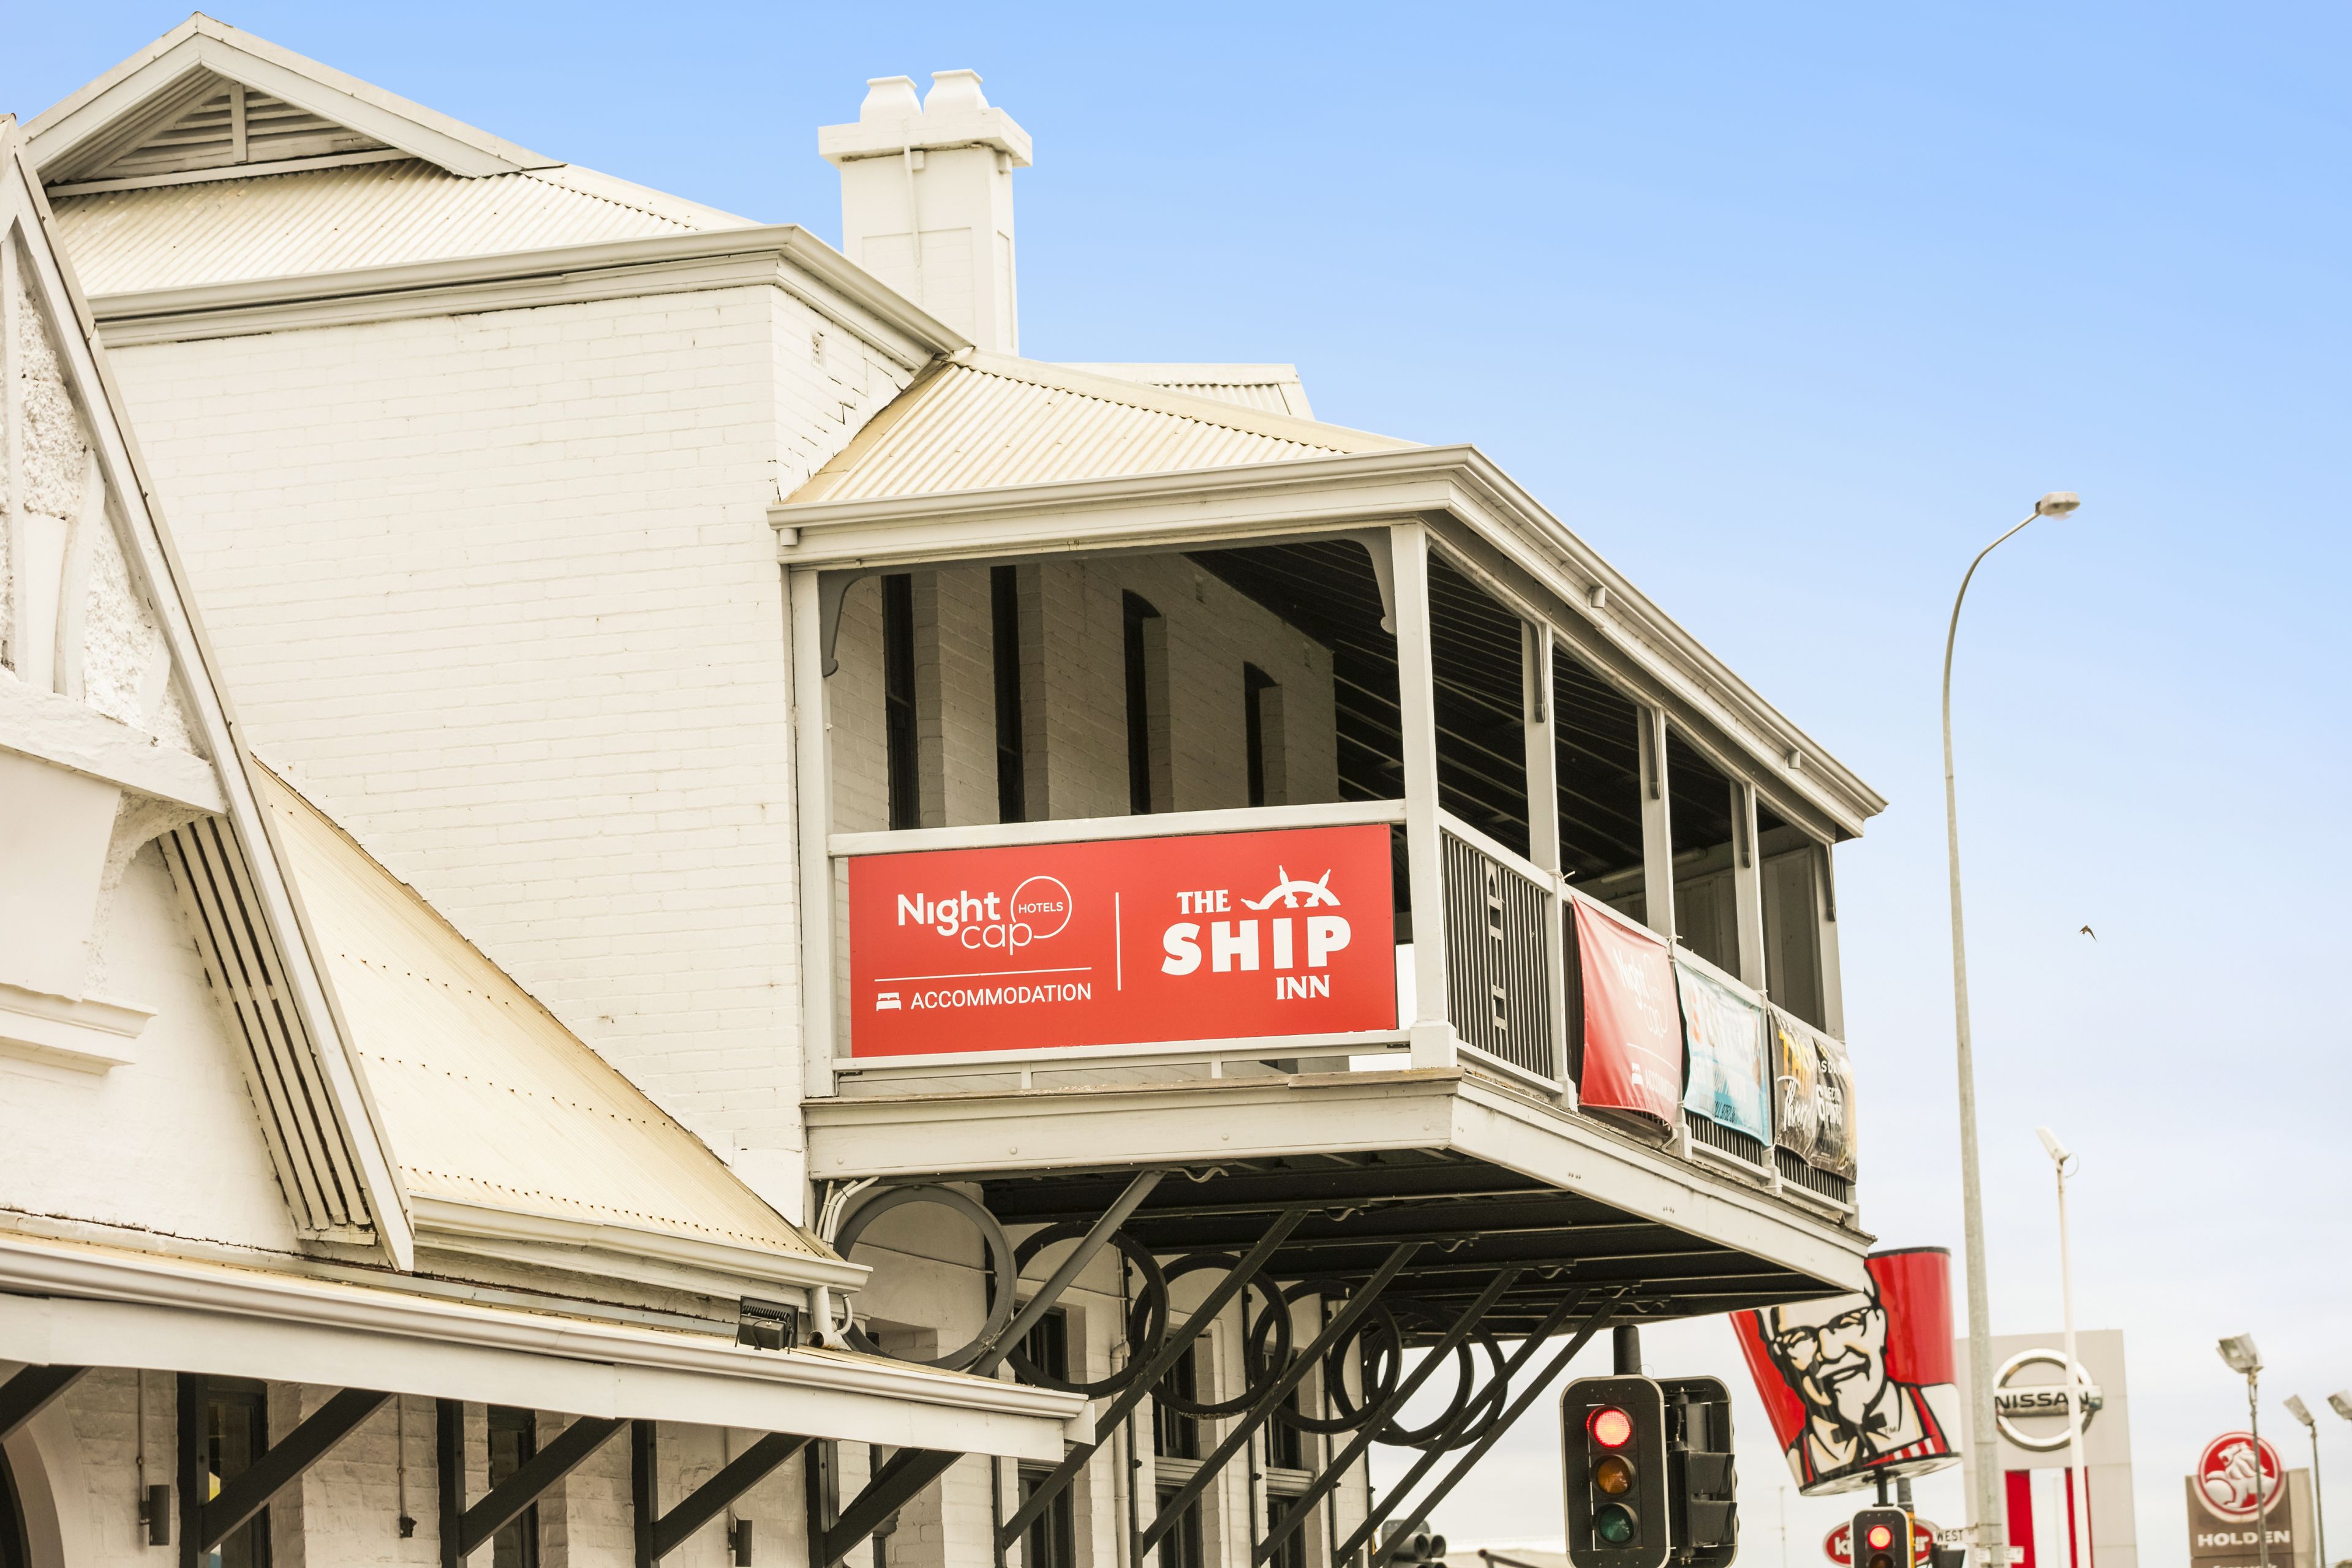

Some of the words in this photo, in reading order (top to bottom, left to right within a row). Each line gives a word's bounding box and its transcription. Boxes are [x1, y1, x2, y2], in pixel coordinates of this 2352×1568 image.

[897, 890, 1001, 937] Night
[1018, 902, 1064, 914] HOTELS
[1176, 889, 1231, 914] THE
[961, 922, 1033, 956] cap
[1161, 915, 1351, 976] SHIP
[910, 982, 1091, 1009] ACCOMMODATION
[1276, 974, 1330, 1000] INN
[1936, 1529, 1963, 1541] WEST
[2198, 1530, 2291, 1547] HOLDEN
